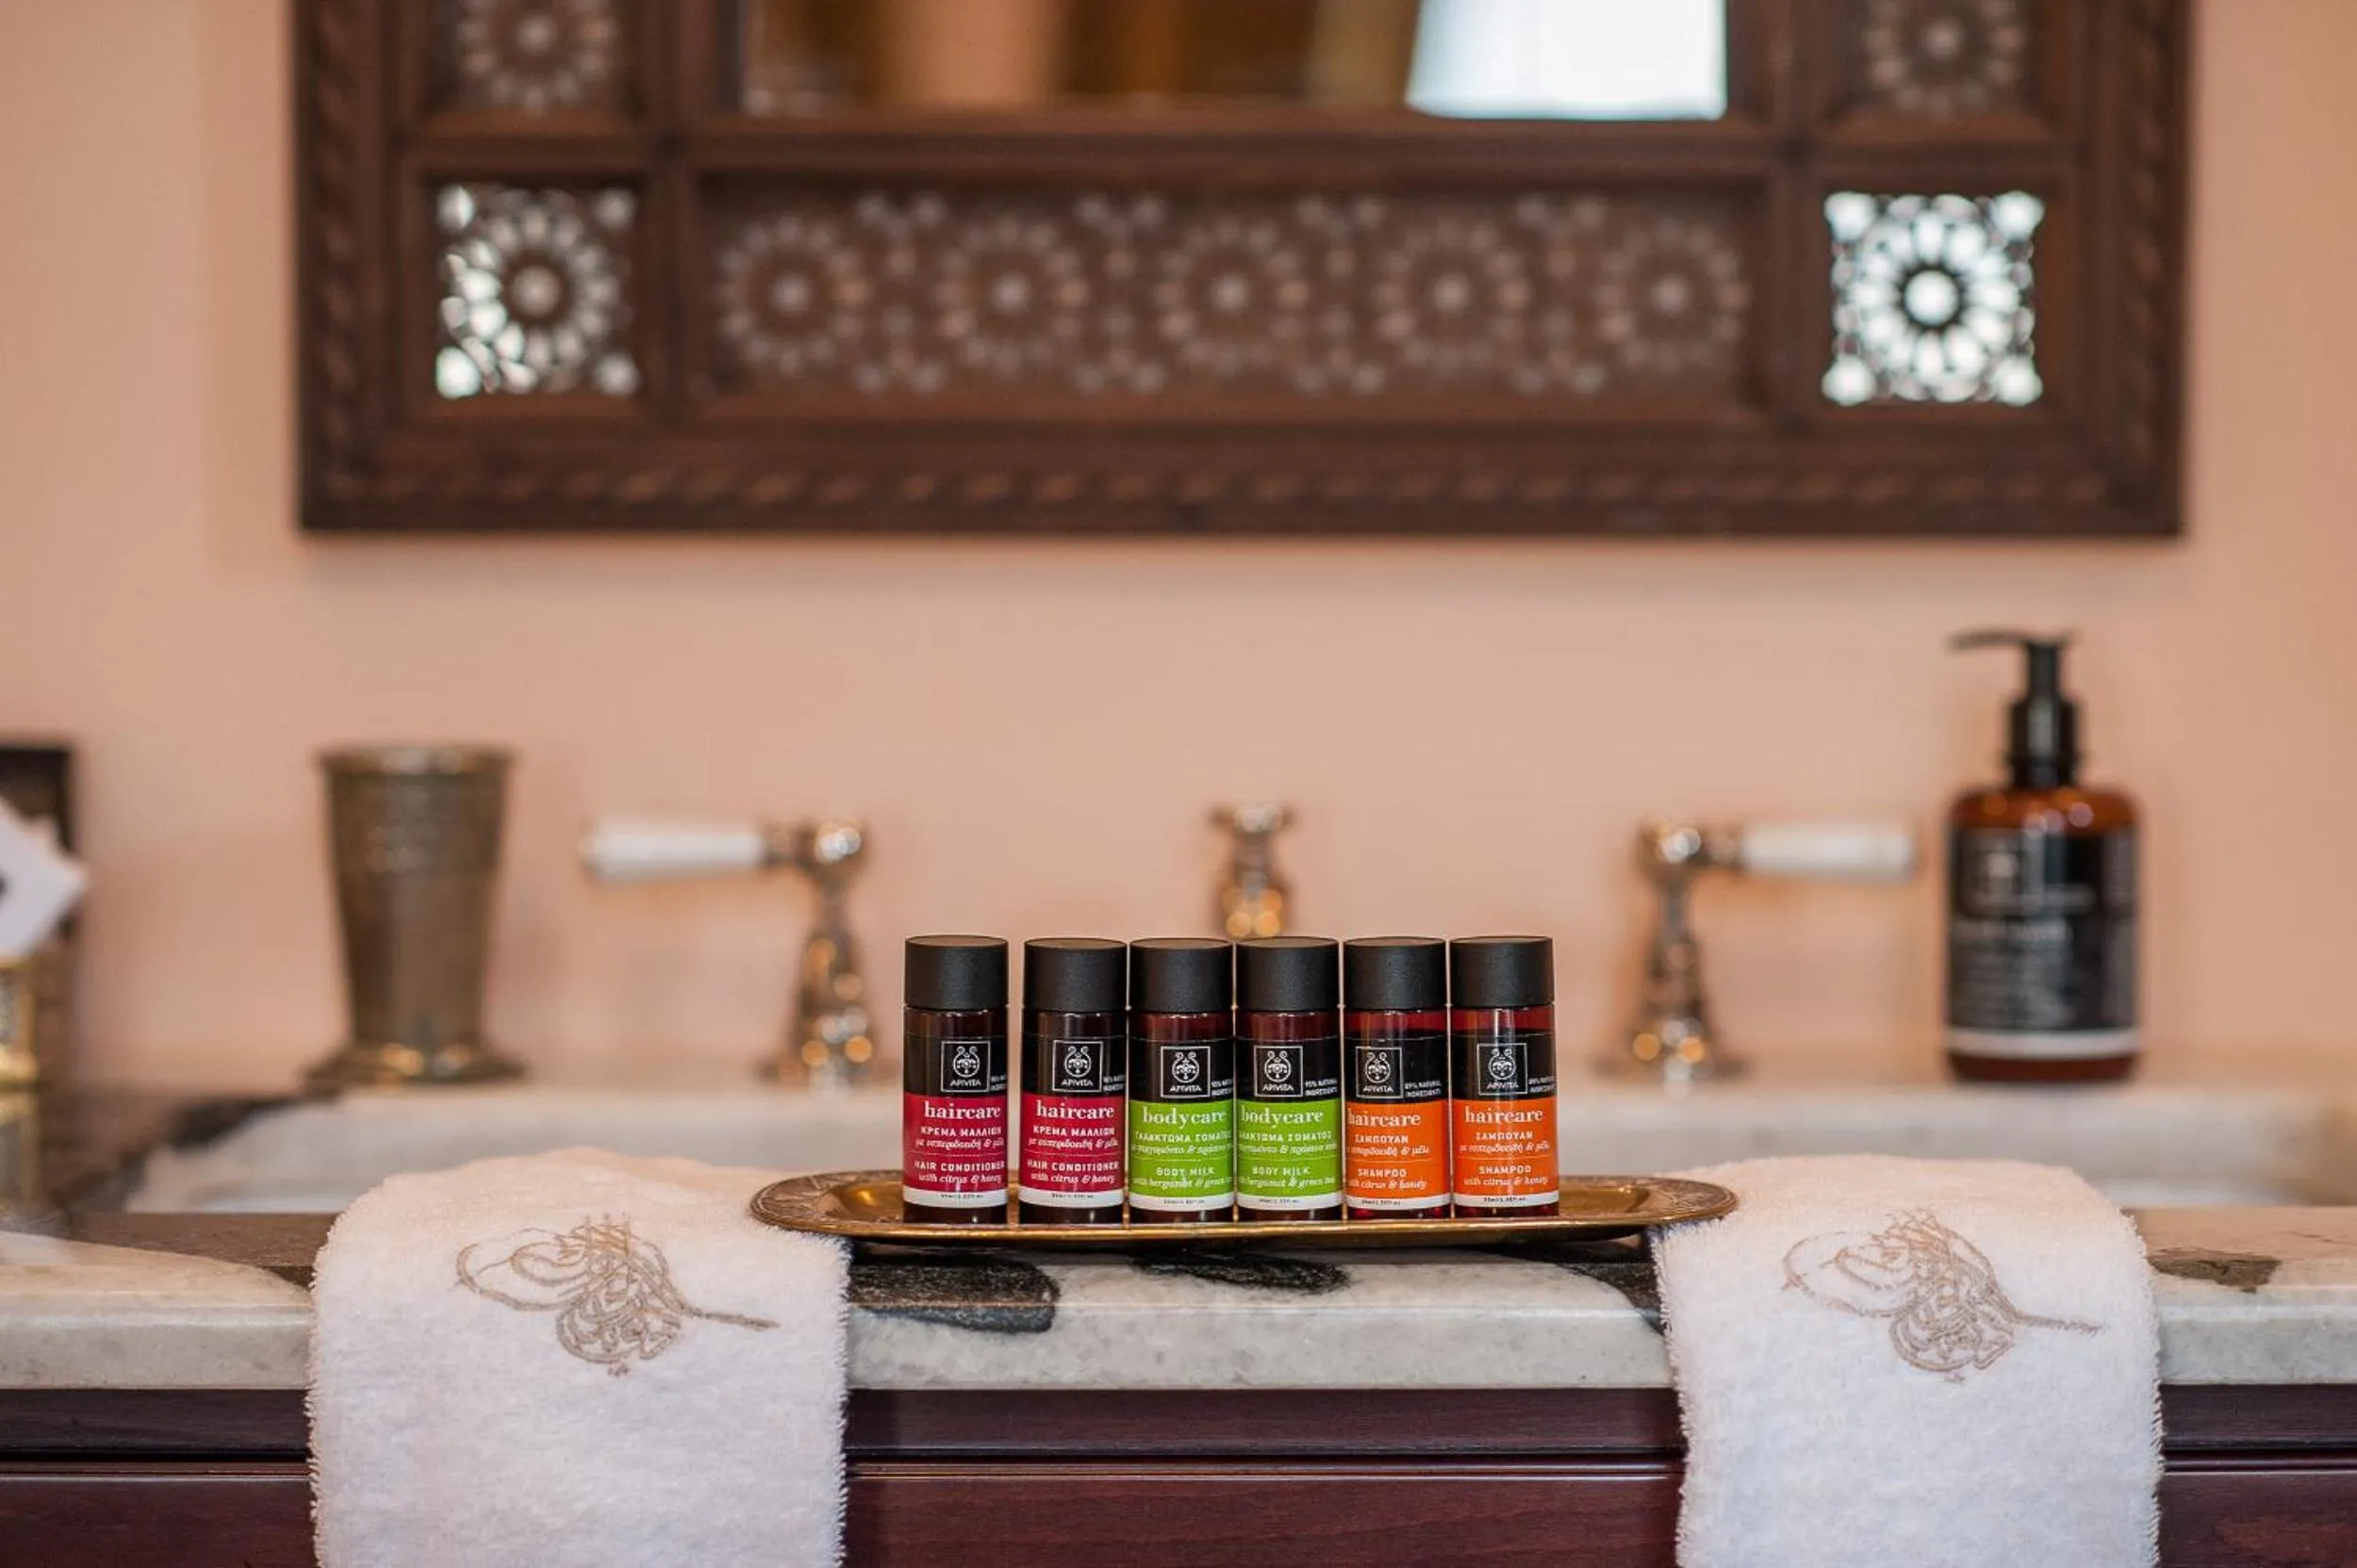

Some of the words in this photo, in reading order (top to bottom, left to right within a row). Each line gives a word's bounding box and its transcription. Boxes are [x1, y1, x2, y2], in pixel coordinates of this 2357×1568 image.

[924, 1101, 1001, 1119] haircare
[1036, 1099, 1114, 1119] haircare
[1143, 1106, 1226, 1130] bodycare
[1242, 1104, 1324, 1129] bodycare
[1348, 1108, 1421, 1127] haircare
[1465, 1106, 1542, 1124] haircare
[1096, 1139, 1104, 1148] &
[1525, 1142, 1534, 1151] &
[1401, 1147, 1410, 1155] &
[914, 1161, 936, 1170] HAIR
[941, 1161, 1005, 1172] CONDITIONER
[1028, 1159, 1047, 1169] HAIR
[1052, 1161, 1119, 1171] CONDITIONER
[1478, 1165, 1532, 1174] SHAMPOO
[1156, 1167, 1186, 1176] BODY
[1190, 1167, 1215, 1176] MILK
[1252, 1167, 1278, 1176] BODY
[1283, 1166, 1310, 1176] MILK
[918, 1174, 937, 1182] with
[939, 1175, 967, 1183] citrus
[970, 1175, 980, 1183] &
[1030, 1172, 1048, 1181] with
[1051, 1174, 1079, 1183] citrus
[1081, 1175, 1091, 1183] &
[1092, 1175, 1114, 1183] honey
[1288, 1177, 1297, 1188] &
[1464, 1177, 1481, 1185] with
[1514, 1177, 1525, 1186] &
[1389, 1180, 1397, 1188] &
[1399, 1180, 1427, 1190] honey
